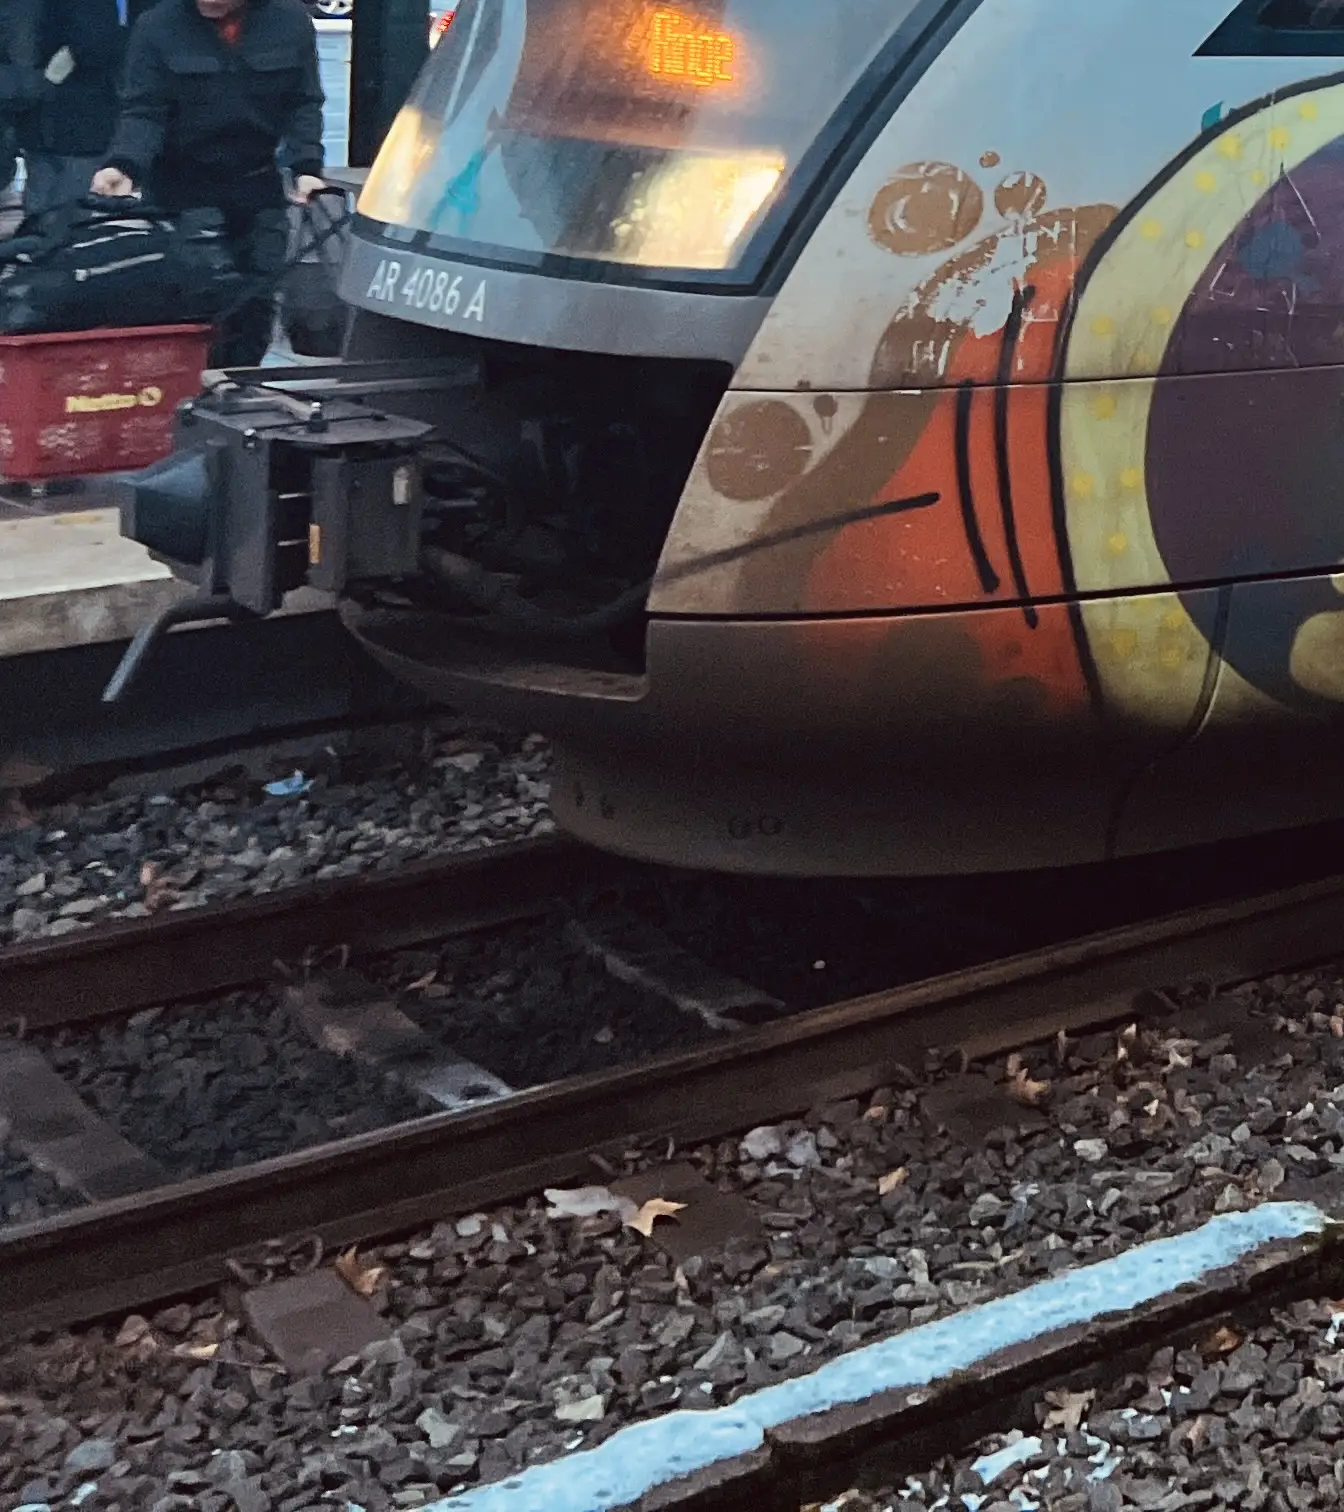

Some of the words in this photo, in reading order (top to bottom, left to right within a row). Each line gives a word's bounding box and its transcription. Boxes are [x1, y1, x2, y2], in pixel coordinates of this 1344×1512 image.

[366, 260, 401, 303] AR
[401, 268, 463, 316] 4086
[463, 280, 486, 322] A
